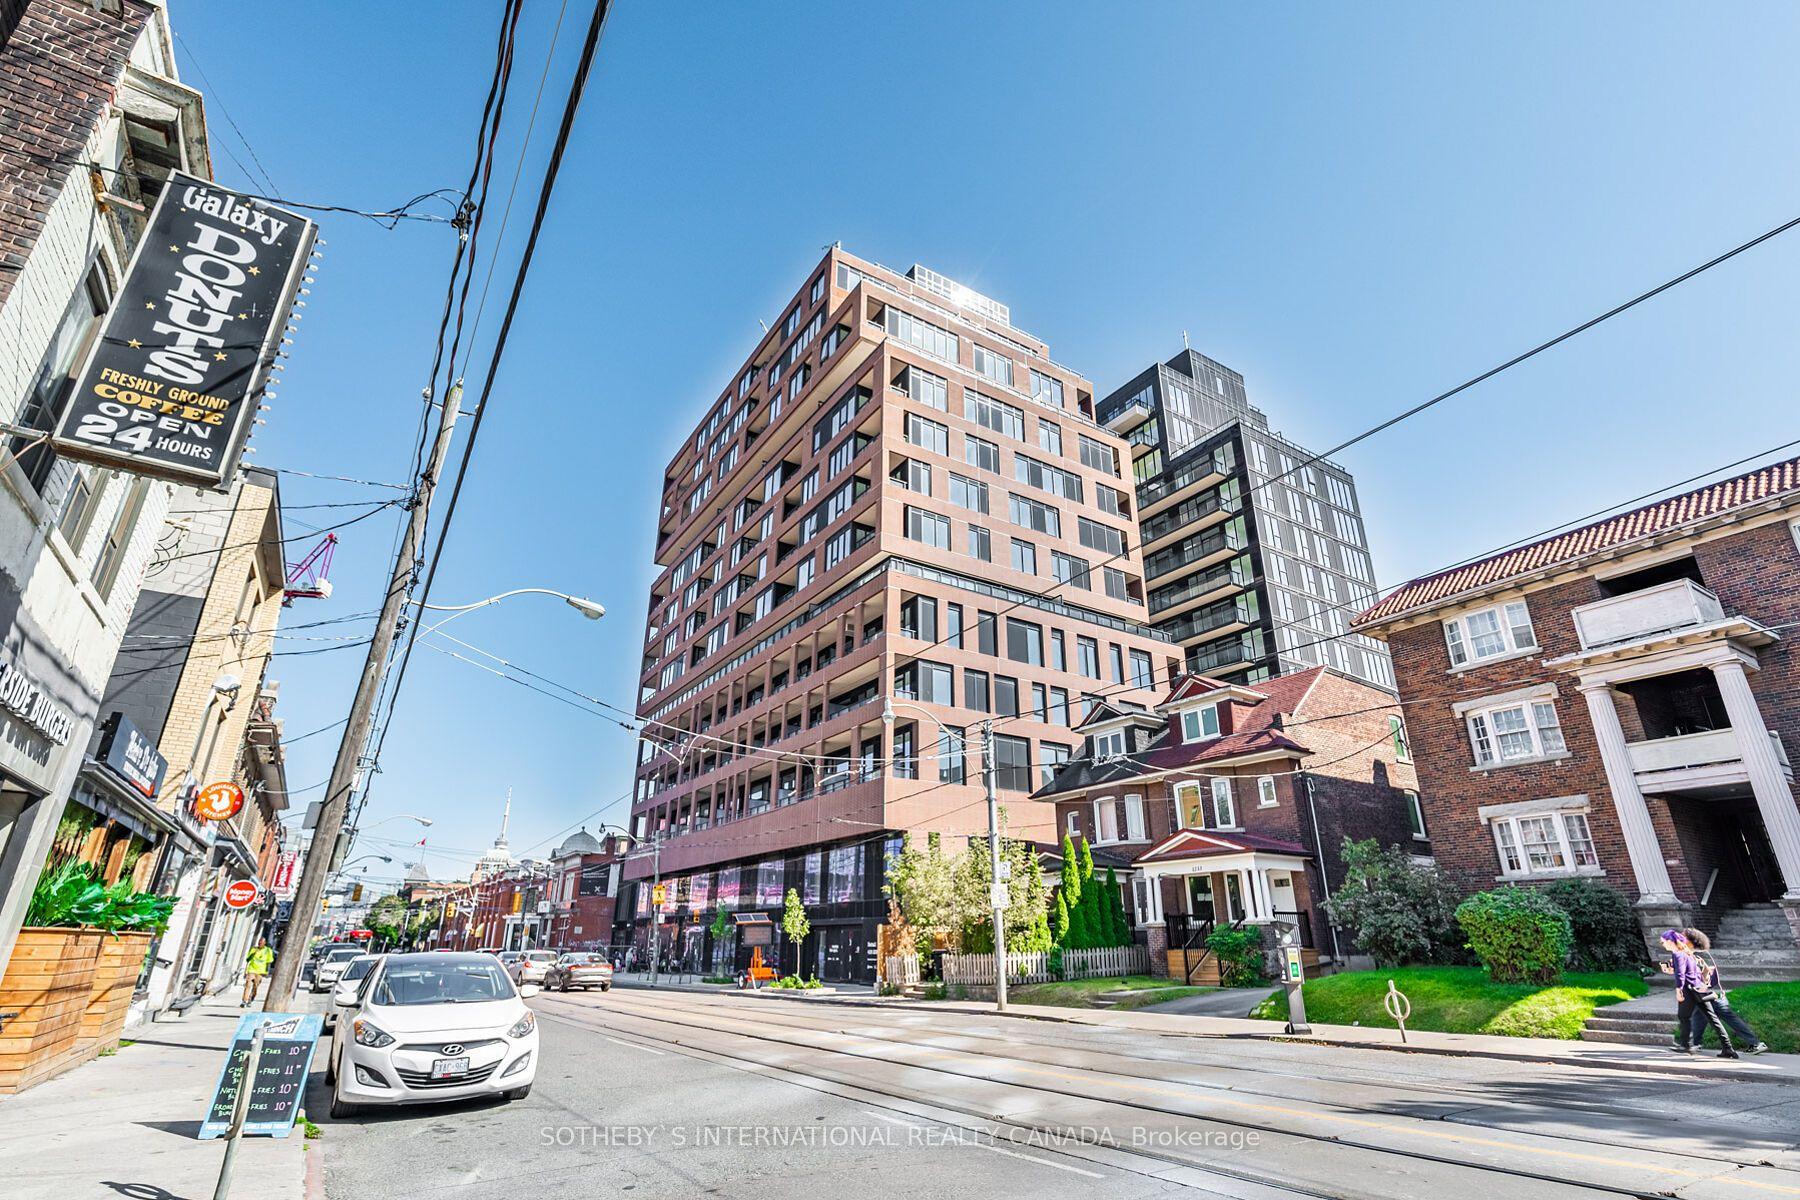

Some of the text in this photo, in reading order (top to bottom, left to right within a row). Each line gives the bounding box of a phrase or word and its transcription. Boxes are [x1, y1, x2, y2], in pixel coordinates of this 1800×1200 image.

[182, 185, 289, 244] Galaxy
[143, 221, 257, 385] DONUTS
[94, 383, 225, 425] COFFEE
[100, 367, 230, 411] FRESHLY GROUND
[74, 414, 213, 460] 24 HOURS
[98, 402, 211, 439] OPEN
[0, 663, 75, 747] RSIDE BURGERS
